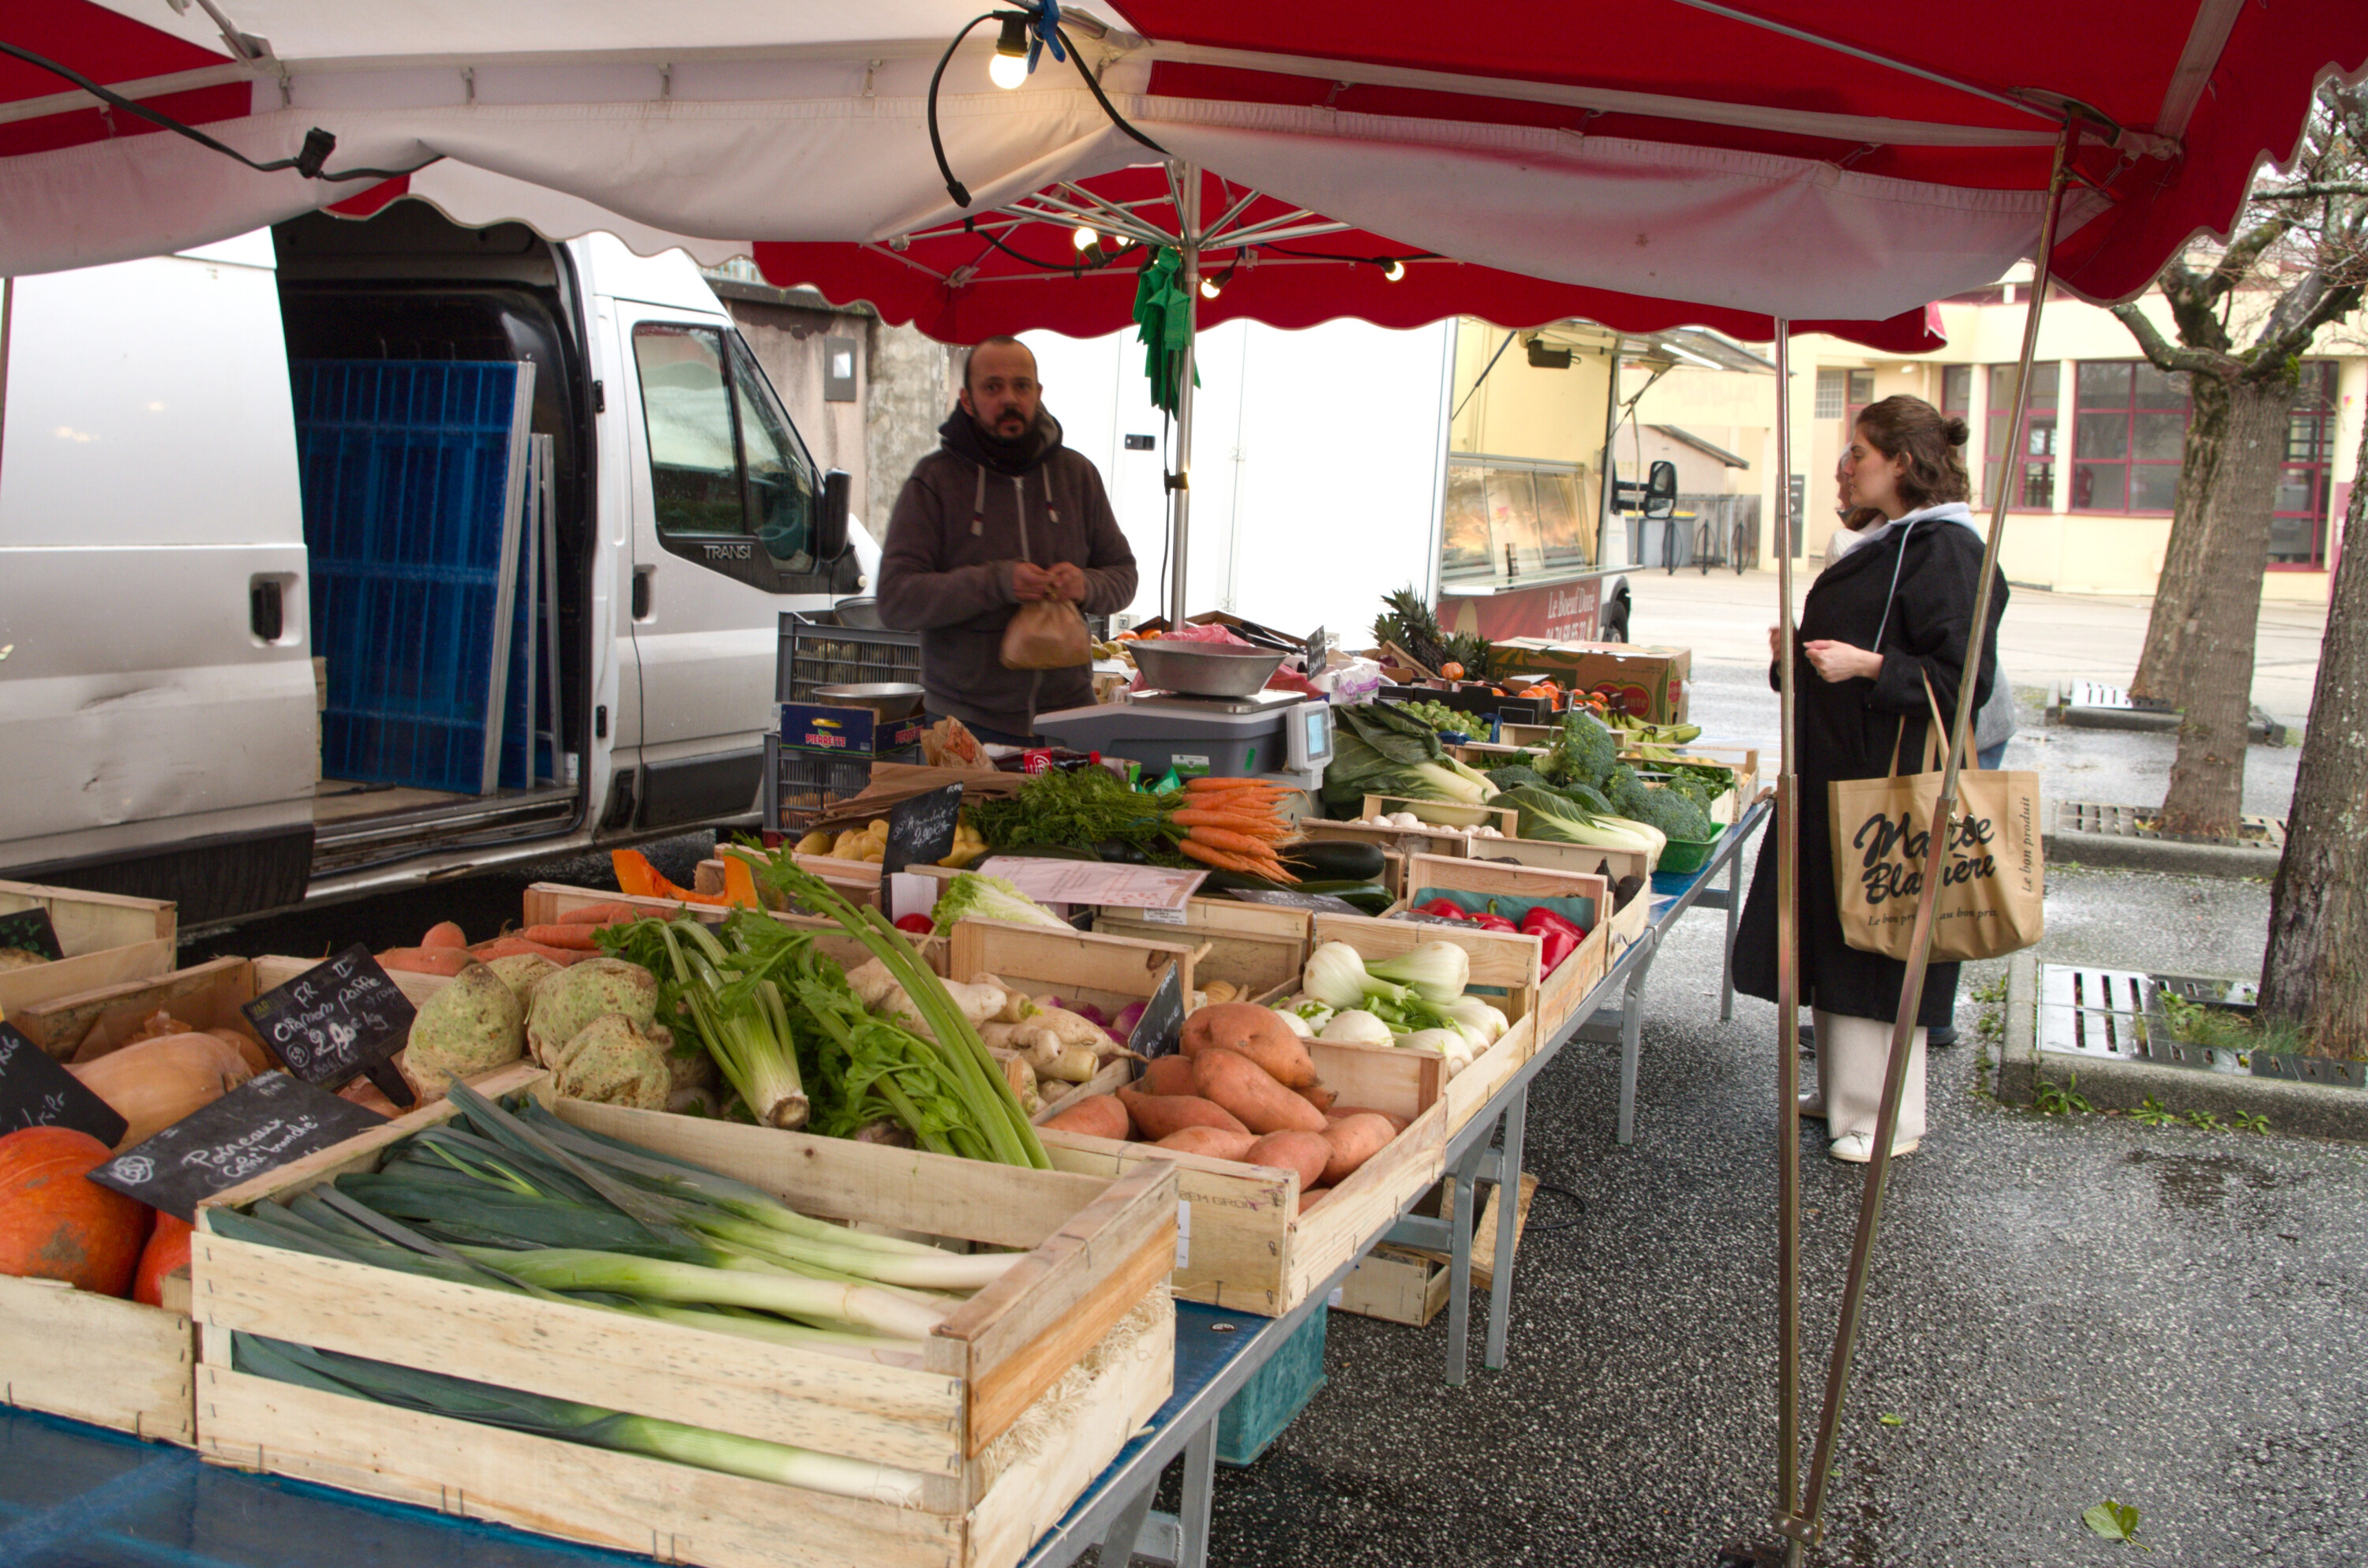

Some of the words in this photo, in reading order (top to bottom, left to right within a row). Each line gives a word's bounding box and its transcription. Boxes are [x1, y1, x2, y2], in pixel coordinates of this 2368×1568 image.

[1548, 592, 1557, 619] Le
[1579, 586, 1595, 613] Doré
[1623, 698, 1647, 709] onte
[805, 734, 846, 747] PIERRETTE
[2019, 797, 2034, 847] produit
[1853, 812, 1995, 868] Maie
[2019, 850, 2032, 874] bon
[1861, 853, 1996, 904] Blaère
[2022, 878, 2032, 893] Le
[1868, 916, 1880, 926] Le
[1883, 914, 1898, 923] bon
[1957, 907, 1974, 917] bon
[294, 981, 318, 1009] FR
[181, 1118, 284, 1168] Poireaux
